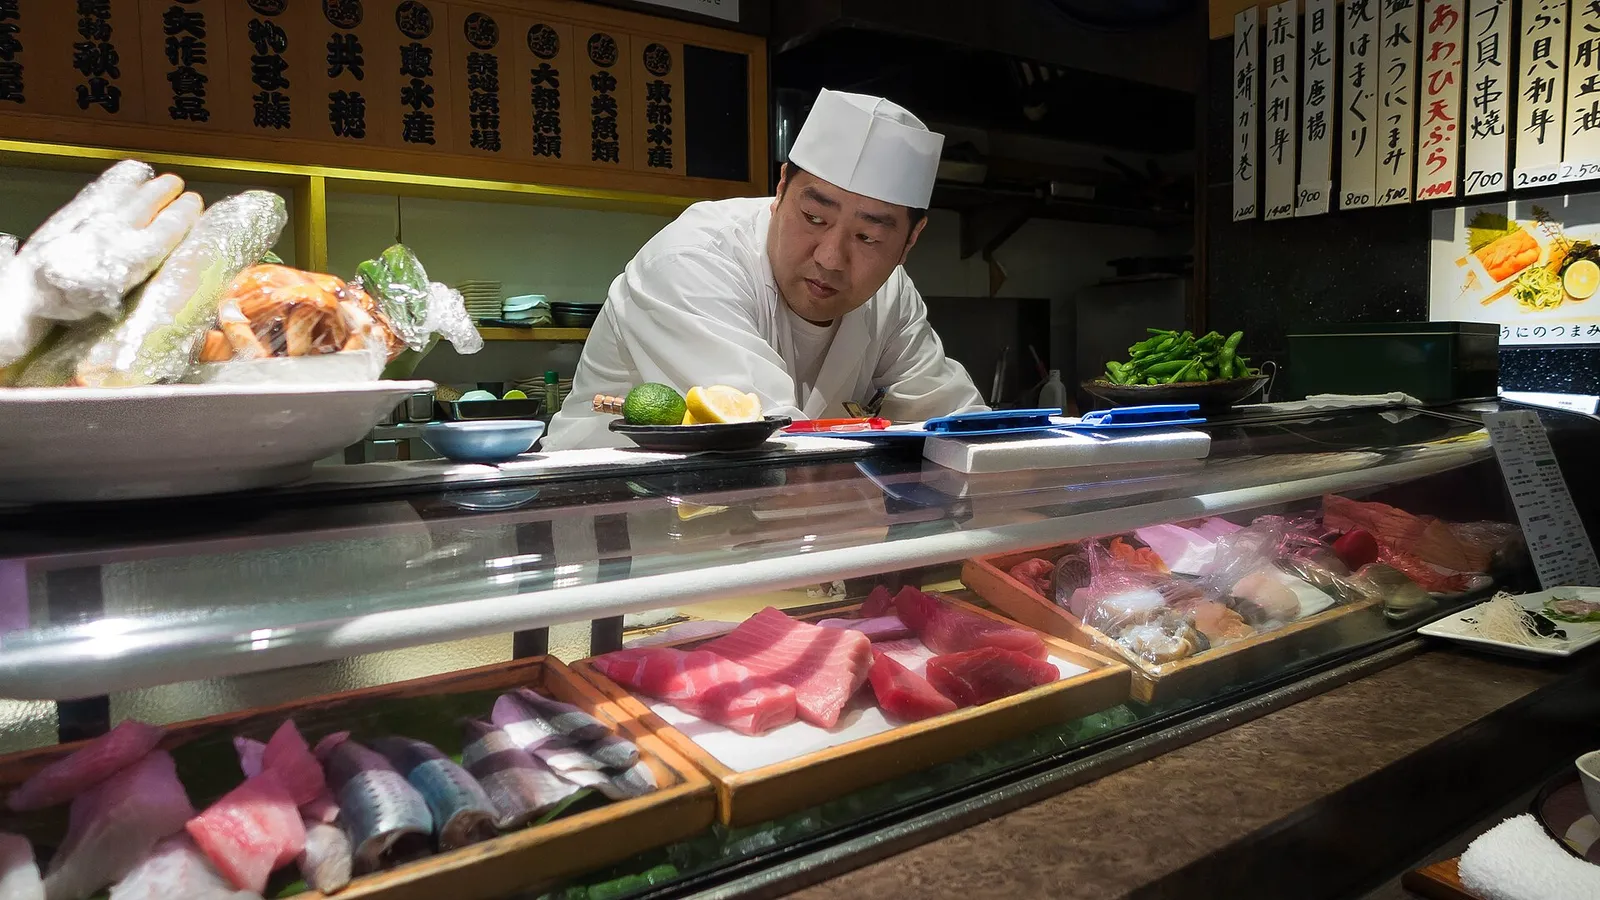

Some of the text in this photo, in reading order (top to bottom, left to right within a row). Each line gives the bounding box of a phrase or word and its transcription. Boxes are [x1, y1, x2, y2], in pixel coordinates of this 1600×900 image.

[163, 5, 210, 122] 矢作食品
[466, 51, 501, 152] 築地魚市場
[1267, 16, 1296, 165] 赤貝刺身
[1347, 0, 1374, 157] 焼はまぐり
[1422, 3, 1460, 176] あわび天ぷら
[530, 62, 561, 159] 大都魚類
[590, 70, 620, 164] 中央魚類
[646, 80, 673, 169] 東都水産
[1235, 204, 1255, 218] 1200
[1300, 189, 1321, 207] 900
[1345, 193, 1369, 206] 800
[1466, 170, 1503, 193] 700
[1517, 172, 1557, 186] 2000
[1561, 163, 1600, 179] 2.50
